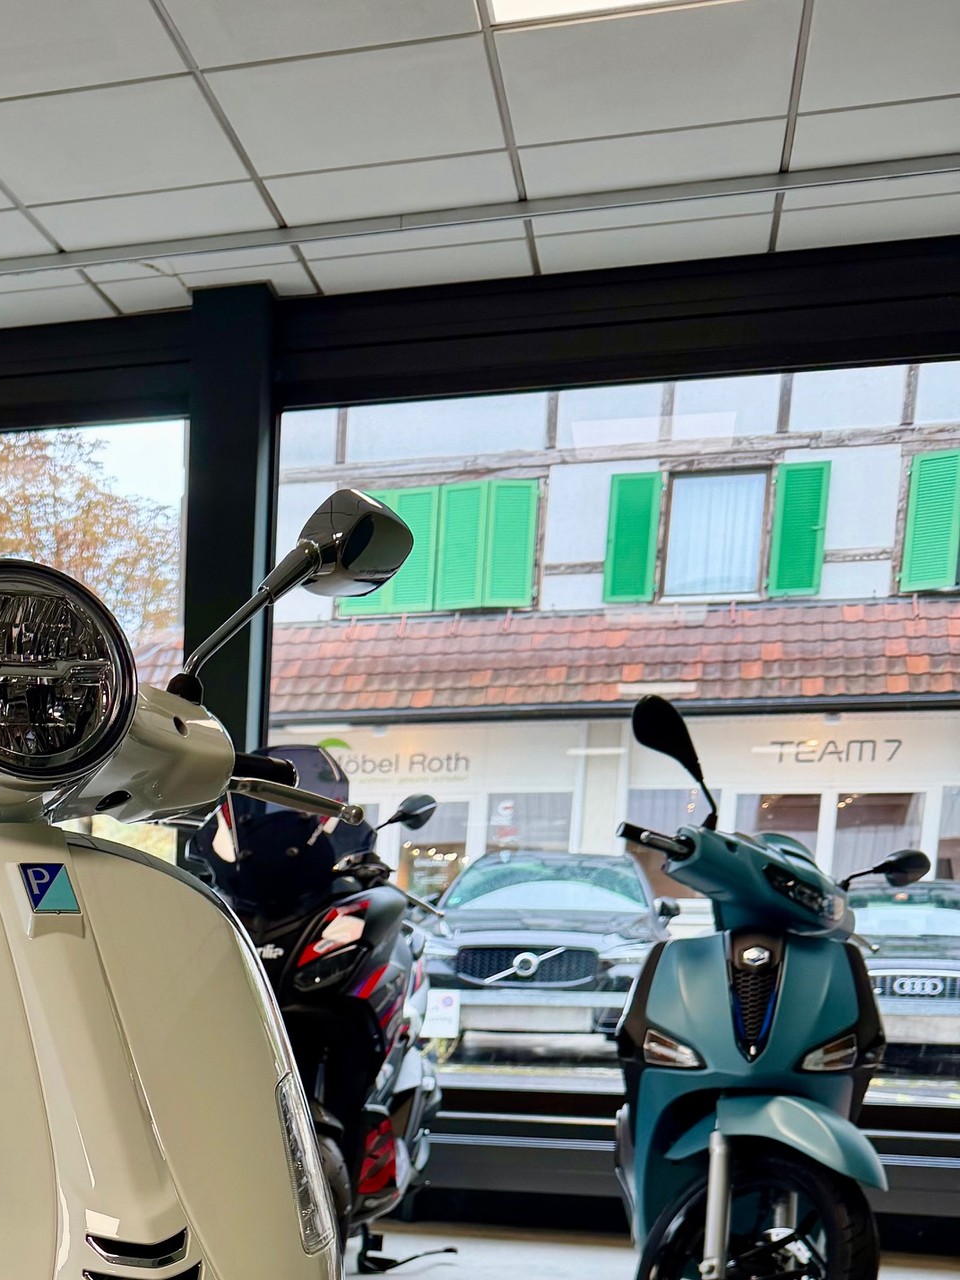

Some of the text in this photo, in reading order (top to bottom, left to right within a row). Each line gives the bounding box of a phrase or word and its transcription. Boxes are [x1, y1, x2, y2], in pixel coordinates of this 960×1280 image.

[337, 751, 470, 775] öbel Roth
[770, 739, 903, 763] TEAM 7
[27, 867, 50, 895] P
